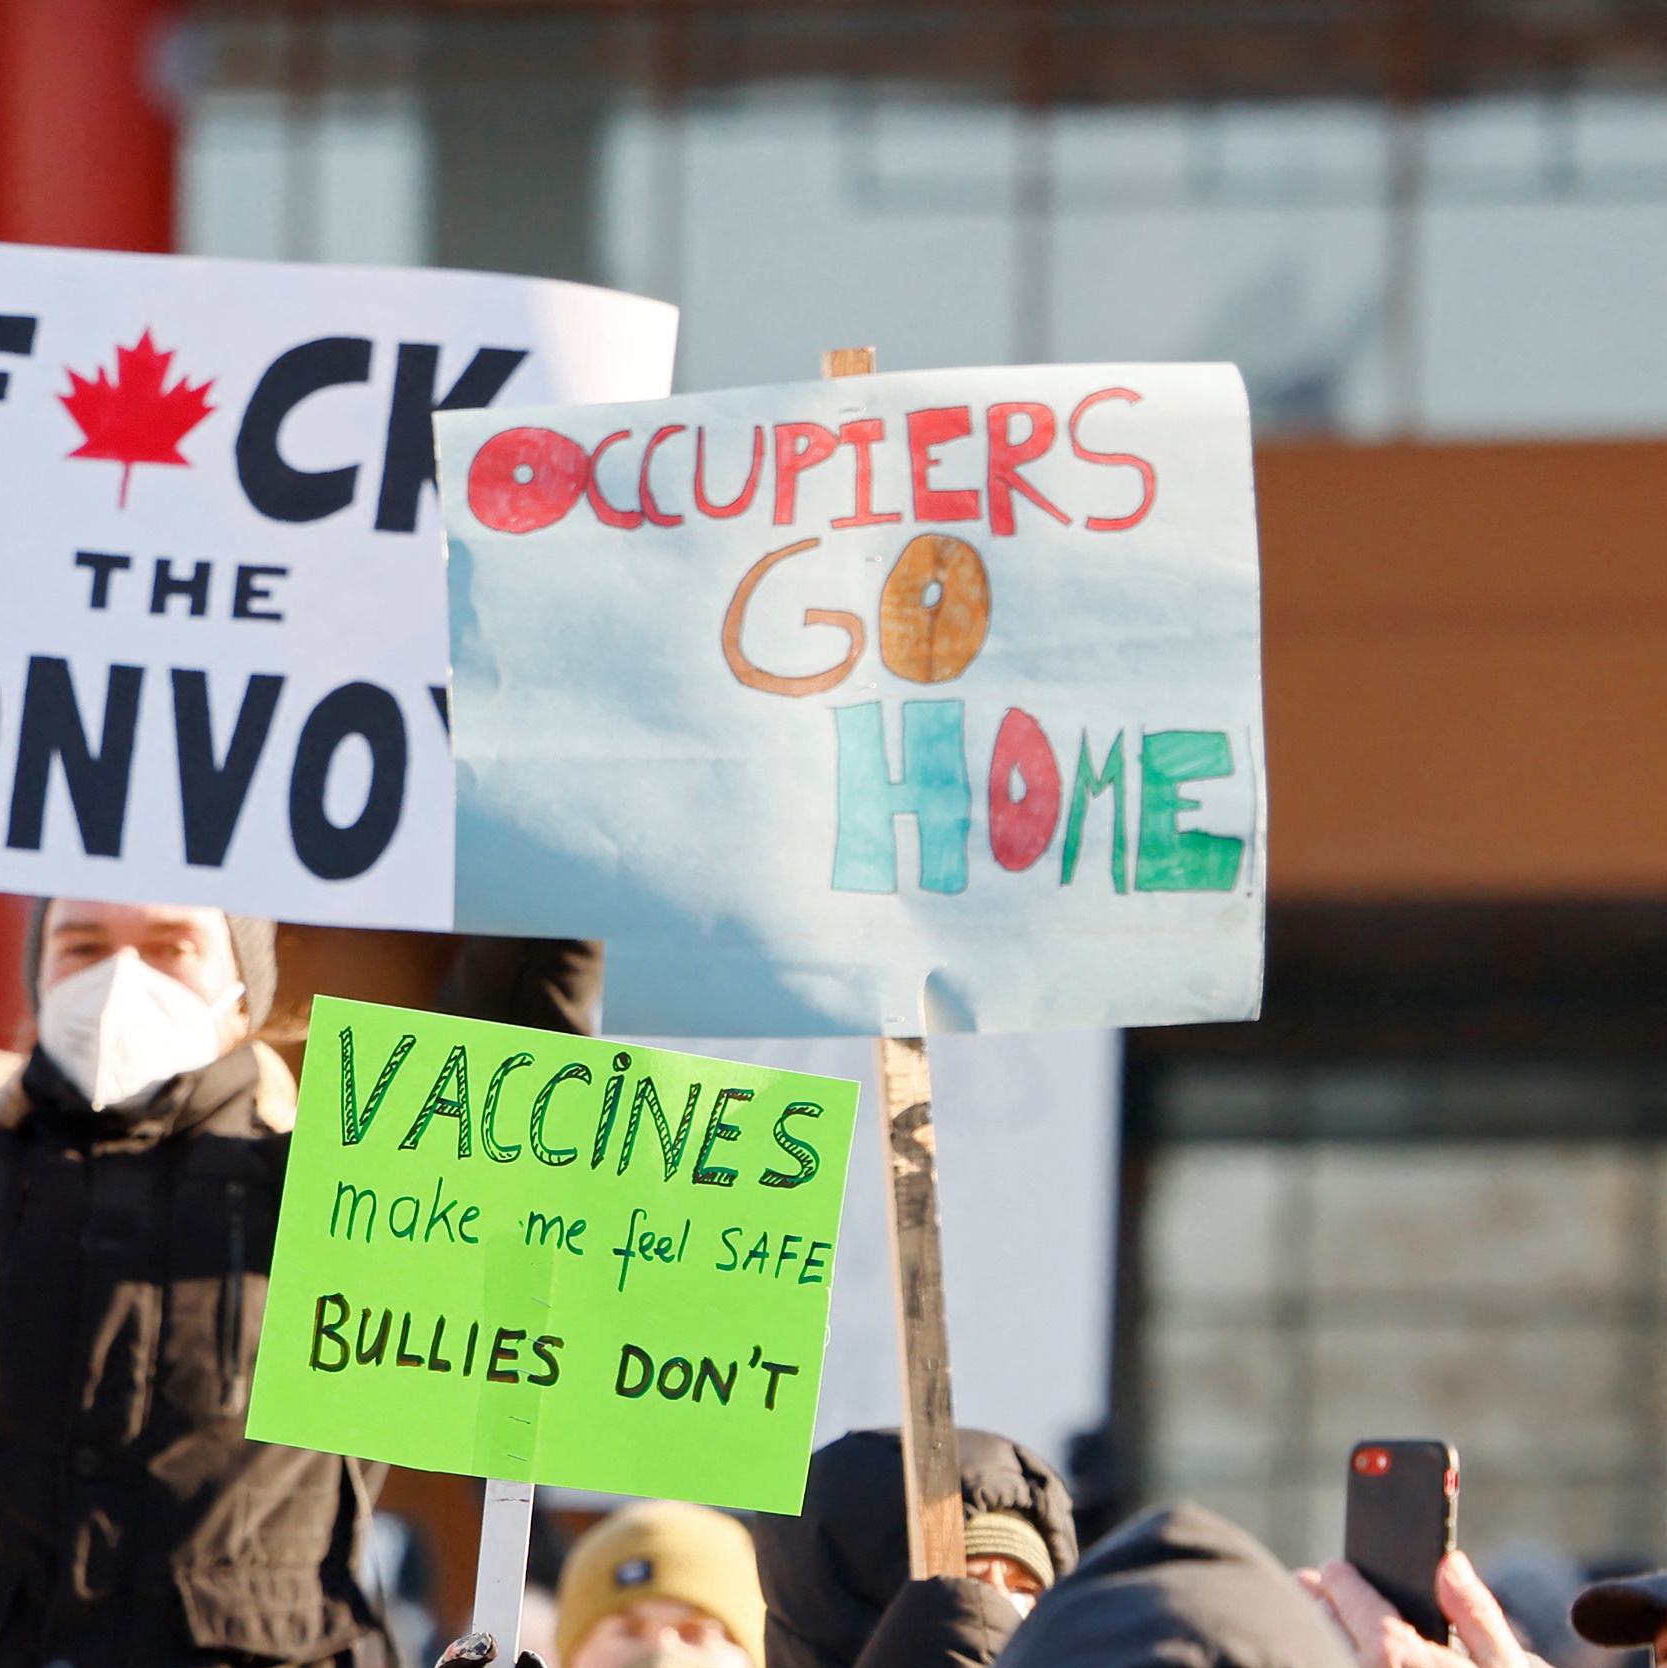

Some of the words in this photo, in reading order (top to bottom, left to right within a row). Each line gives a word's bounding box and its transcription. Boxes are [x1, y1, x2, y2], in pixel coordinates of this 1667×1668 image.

[467, 387, 1156, 537] OCCUPIERS
[73, 549, 290, 624] THE
[721, 533, 993, 698] GO
[338, 1025, 825, 1190] VACCINES
[328, 1175, 481, 1245] make
[524, 1209, 588, 1257] me
[611, 1207, 692, 1294] feel
[714, 1226, 833, 1286] SAFE
[307, 1291, 566, 1388] BULLIES
[613, 1342, 801, 1412] DON'T
